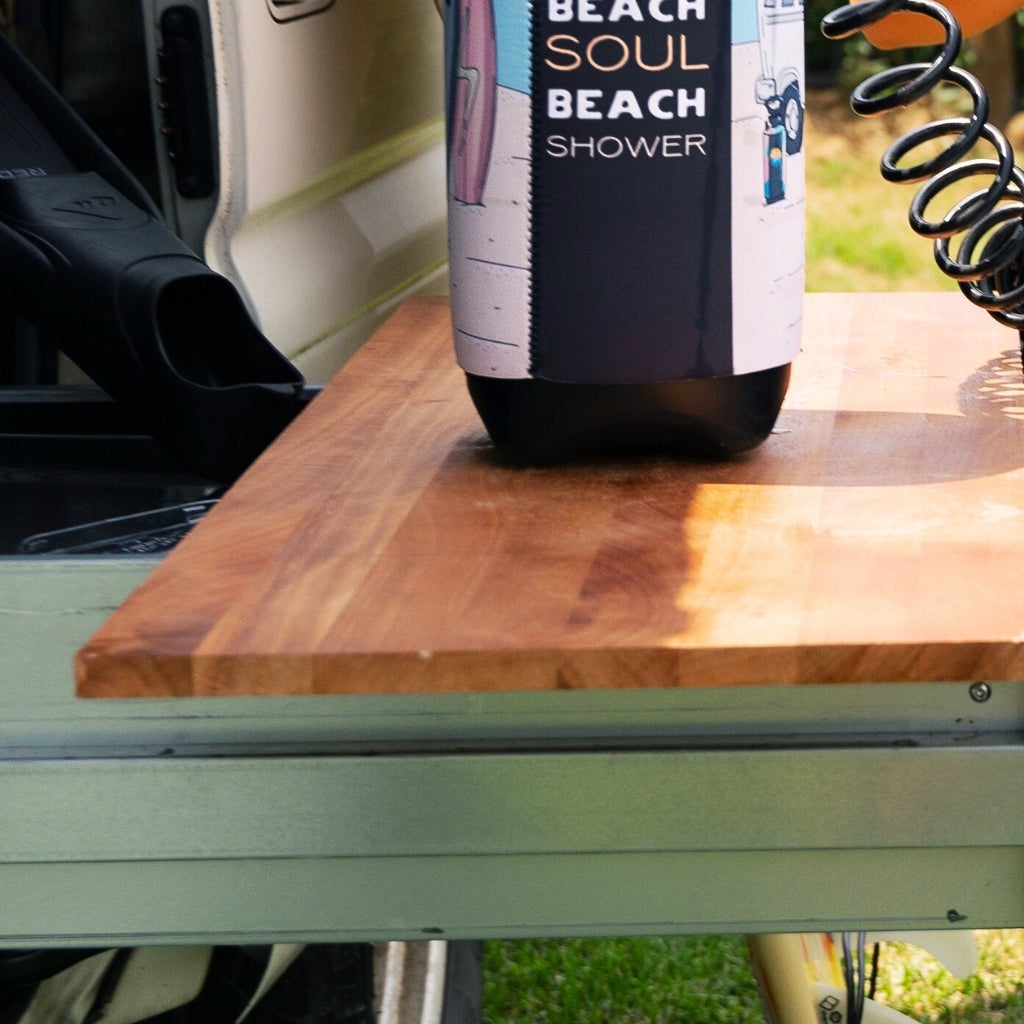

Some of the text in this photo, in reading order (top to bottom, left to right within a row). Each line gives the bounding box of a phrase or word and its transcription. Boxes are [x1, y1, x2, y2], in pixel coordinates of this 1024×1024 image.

[544, 34, 709, 71] SOUL
[547, 87, 706, 119] BEACH
[546, 133, 707, 158] SHOWER
